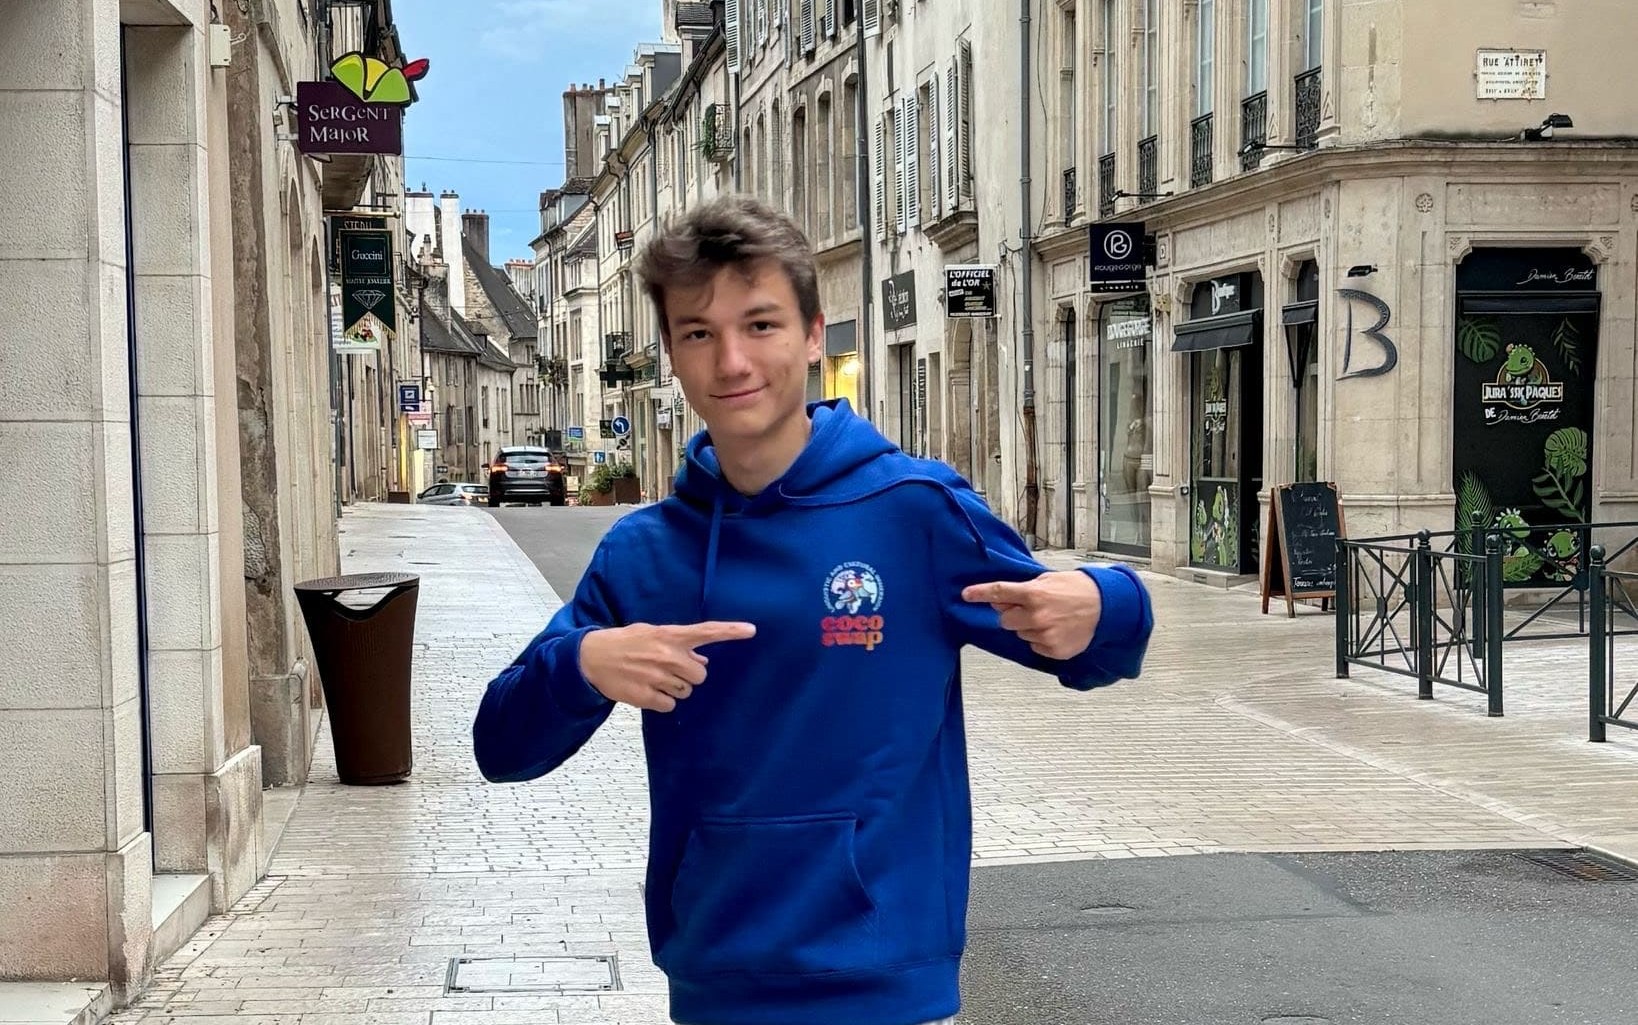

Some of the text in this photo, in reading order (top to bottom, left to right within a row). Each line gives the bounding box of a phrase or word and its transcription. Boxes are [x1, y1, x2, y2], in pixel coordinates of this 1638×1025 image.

[1482, 57, 1499, 67] RUE
[949, 270, 990, 279] L'OFFICIEL
[962, 279, 981, 287] L'OR
[1334, 288, 1398, 382] B
[1484, 407, 1497, 419] DE
